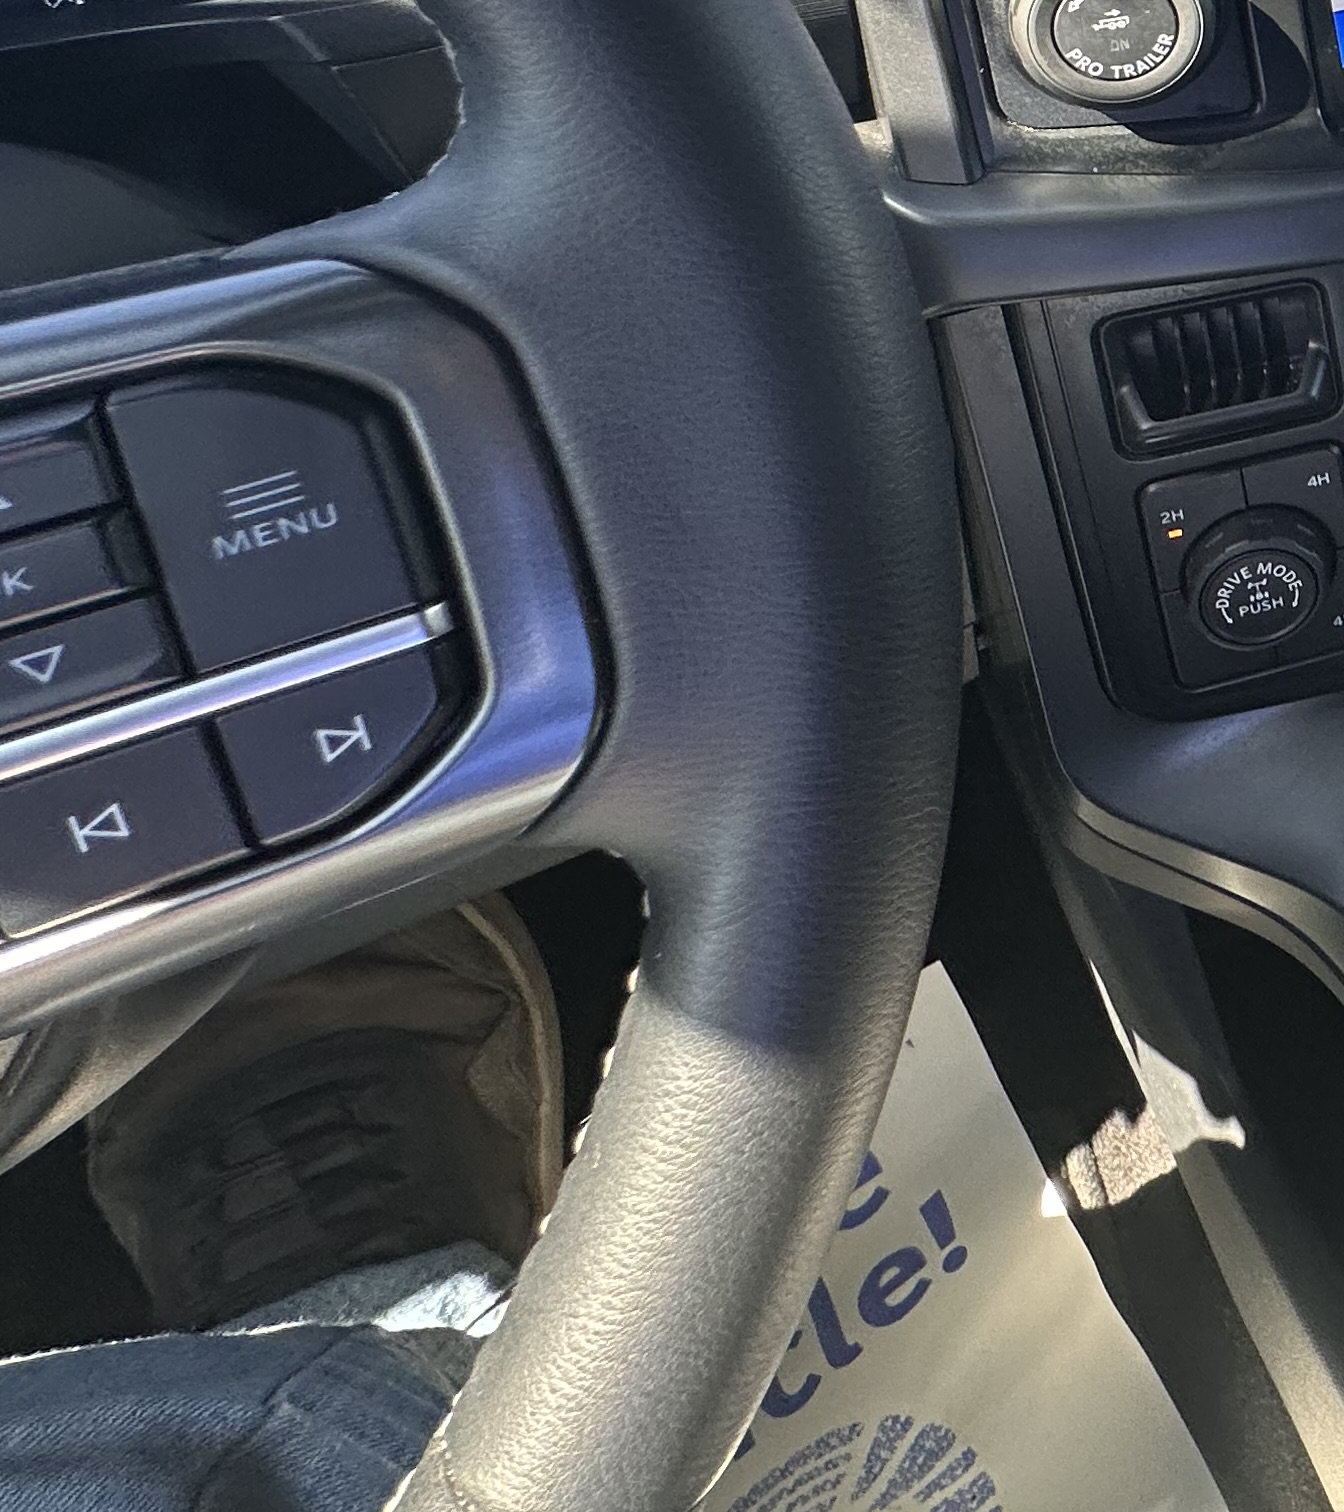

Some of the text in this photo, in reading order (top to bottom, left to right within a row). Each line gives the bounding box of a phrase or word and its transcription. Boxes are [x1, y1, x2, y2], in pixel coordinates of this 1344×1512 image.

[1066, 34, 1175, 78] PRO TRAILER
[1307, 472, 1331, 487] 4H
[209, 502, 339, 560] MENU
[1159, 508, 1185, 525] 2H
[1215, 562, 1304, 610] DRIVE MODE
[1238, 596, 1284, 618] PUSH
[737, 1188, 968, 1459] cle!
